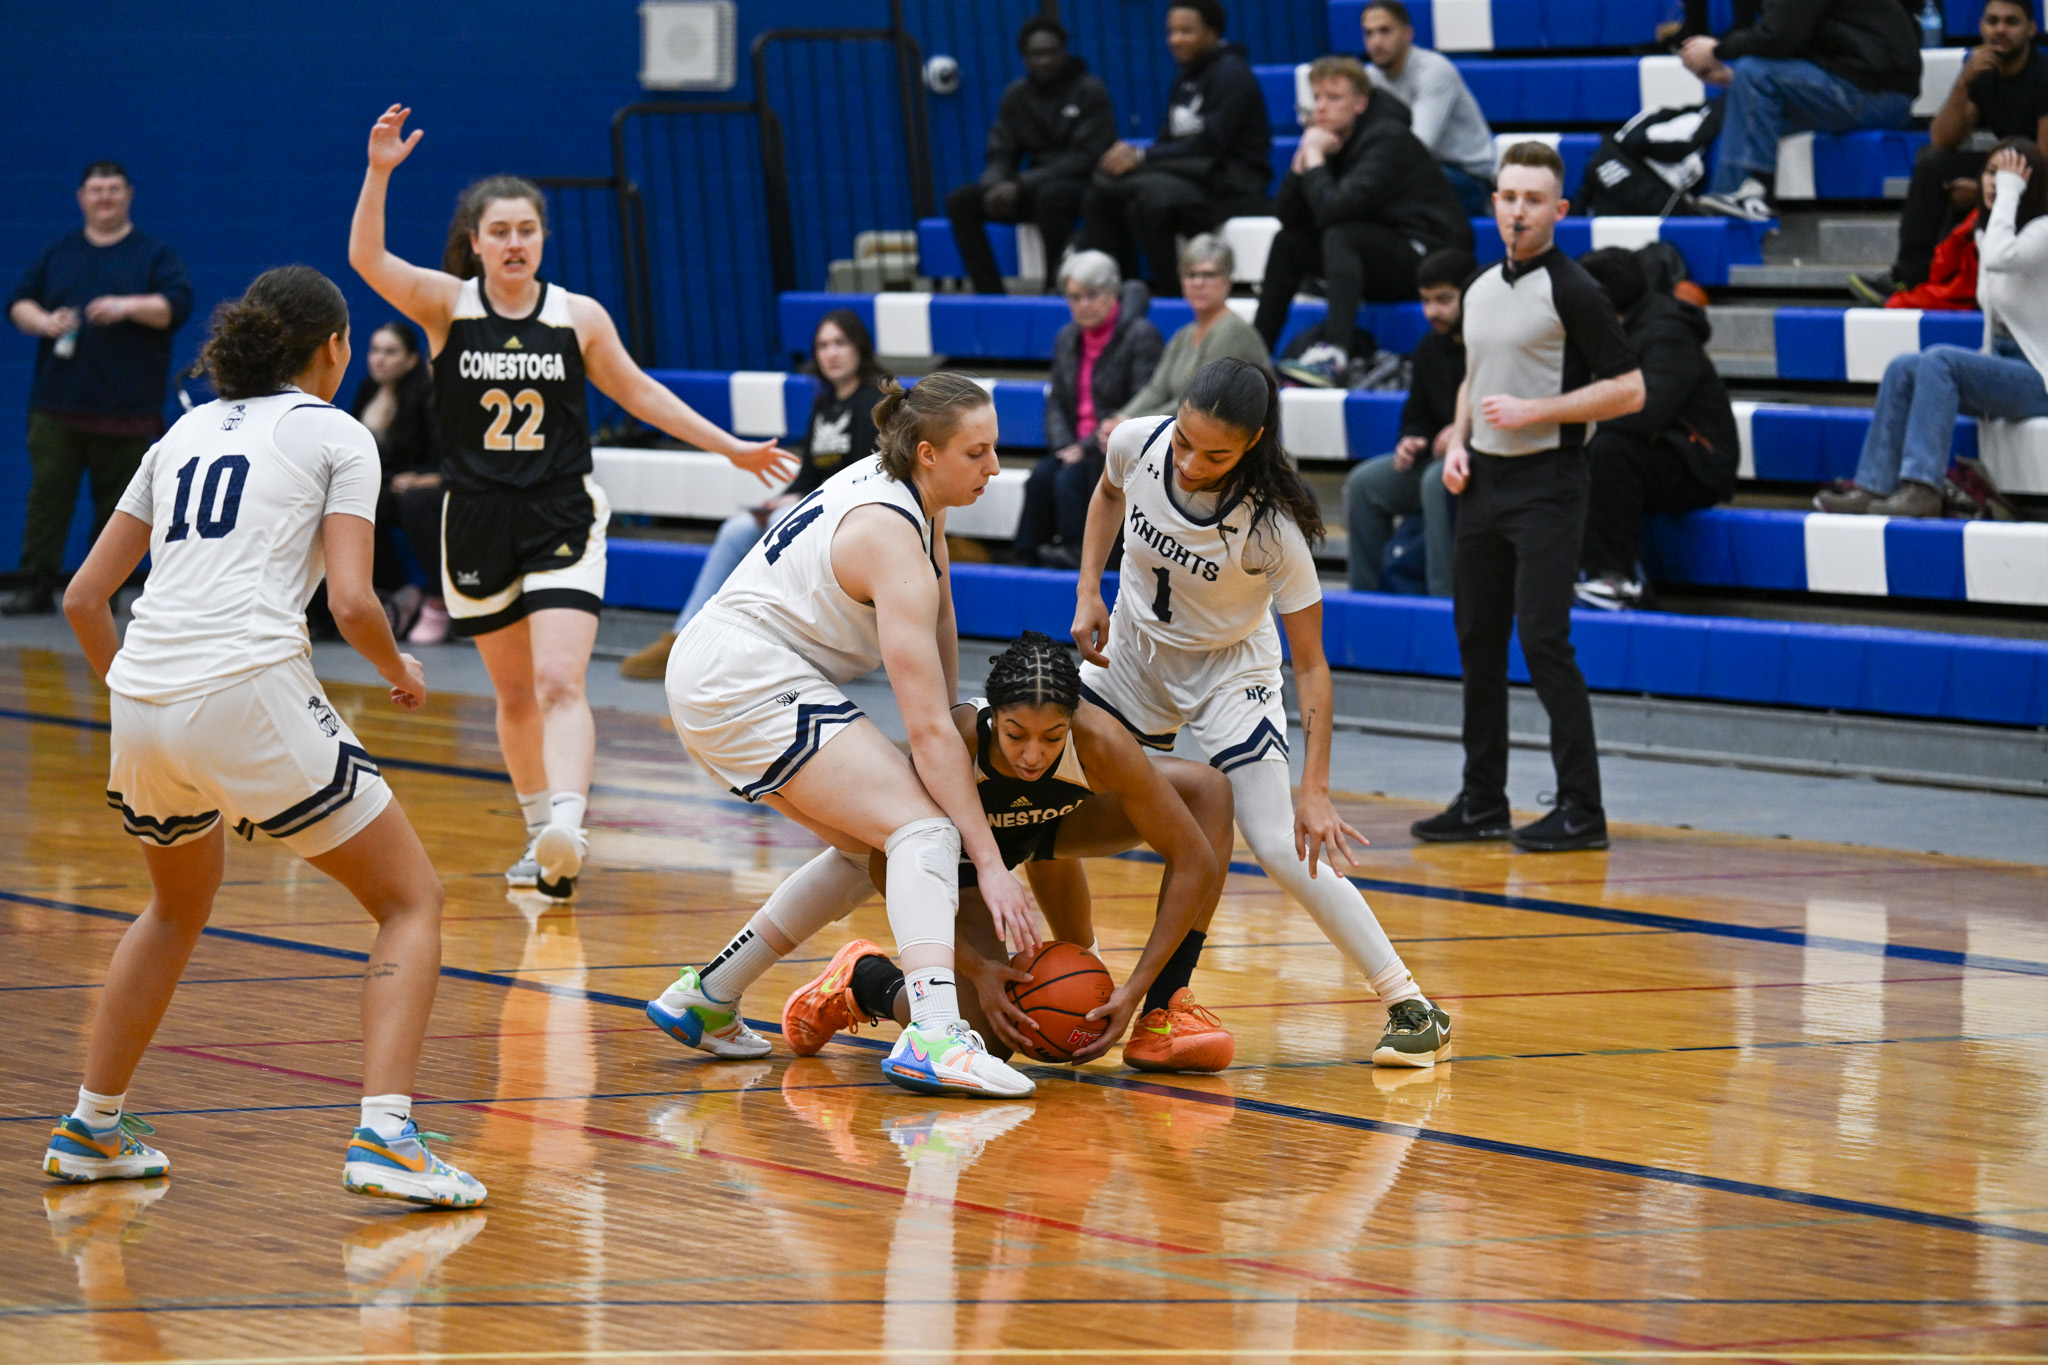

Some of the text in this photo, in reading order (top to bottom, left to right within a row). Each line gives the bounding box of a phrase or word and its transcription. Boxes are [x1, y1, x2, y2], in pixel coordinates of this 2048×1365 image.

[459, 349, 566, 381] CONESTOGA
[480, 388, 545, 451] 22
[165, 454, 251, 543] 10
[763, 489, 824, 567] 14
[1130, 503, 1220, 582] KNIGHTS
[1151, 566, 1173, 624] 1
